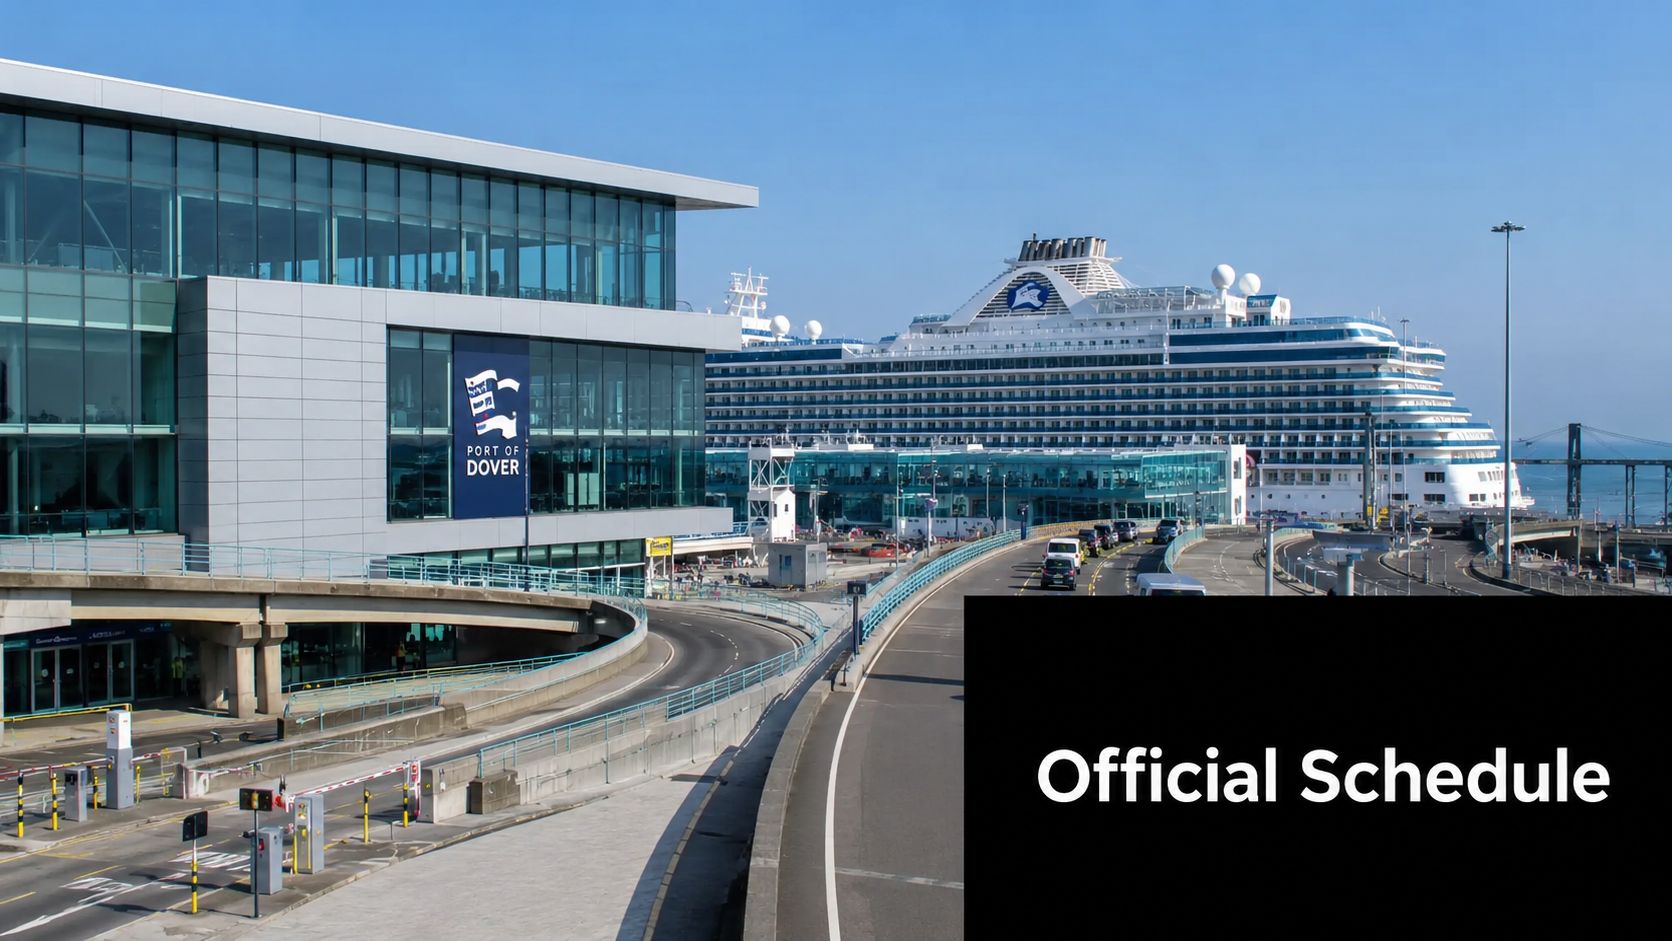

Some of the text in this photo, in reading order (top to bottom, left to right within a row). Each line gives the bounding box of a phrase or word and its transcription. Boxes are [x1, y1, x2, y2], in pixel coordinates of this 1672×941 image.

[467, 445, 520, 457] PORT OF
[467, 459, 520, 476] DOVER
